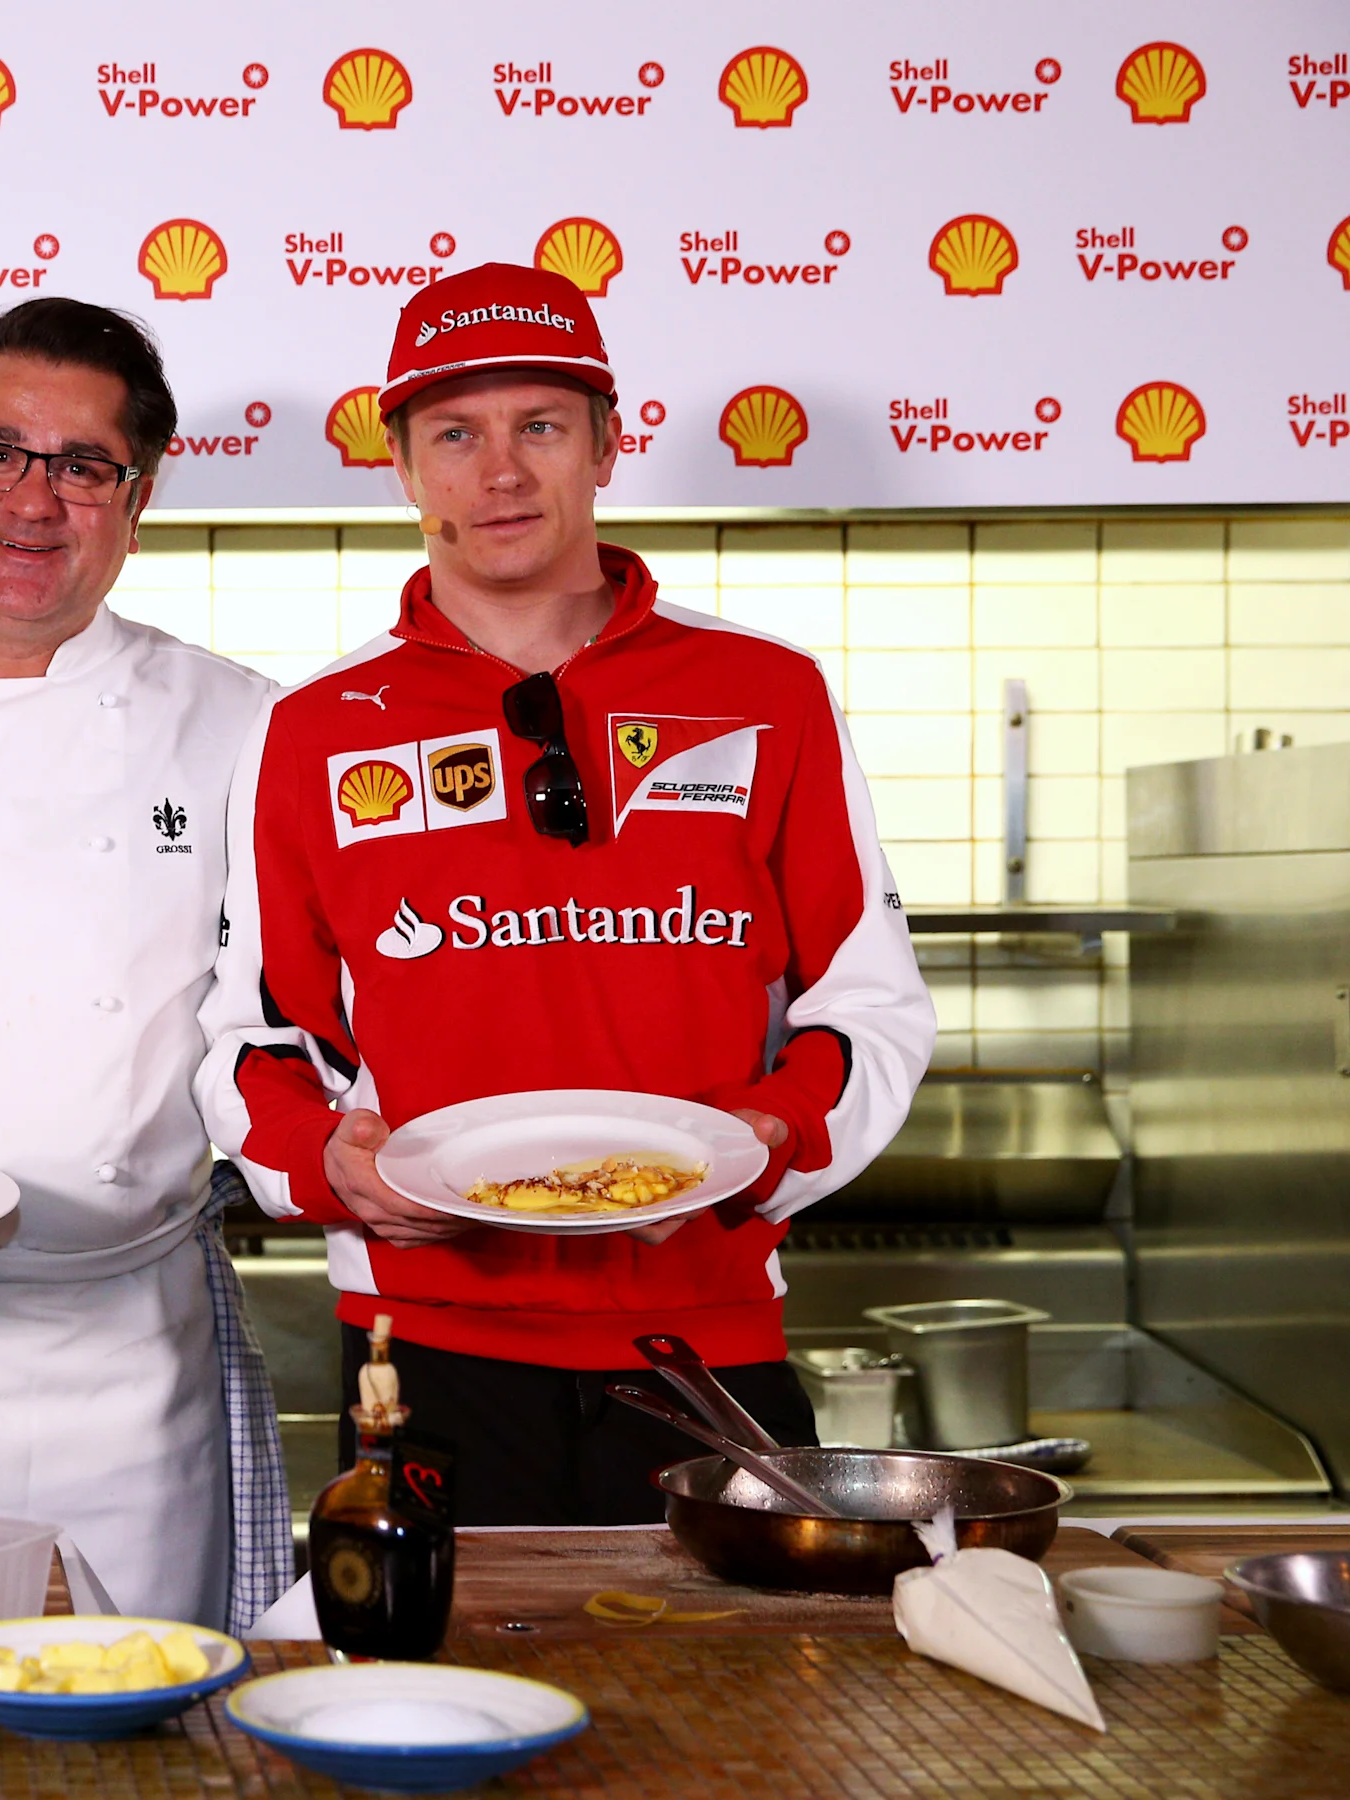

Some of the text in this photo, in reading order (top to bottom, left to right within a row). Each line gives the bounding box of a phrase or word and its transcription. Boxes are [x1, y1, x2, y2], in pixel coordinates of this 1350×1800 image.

[97, 63, 156, 85] Shell
[492, 62, 552, 84] Shell
[888, 59, 948, 81] Shell
[1288, 53, 1348, 76] Shell
[97, 88, 256, 118] V-Power
[494, 88, 652, 117] V-Power
[889, 84, 1049, 114] V-Power
[284, 232, 343, 254] Shell
[679, 230, 738, 253] Shell
[1075, 226, 1135, 249] Shell
[285, 257, 443, 287] V-Power
[680, 256, 839, 286] V-Power
[1076, 251, 1236, 282] V-Power
[440, 303, 576, 334] Santander
[888, 398, 948, 420] Shell
[1287, 393, 1347, 416] Shell
[164, 435, 259, 457] ower
[889, 424, 1050, 453] V-Power
[433, 762, 491, 802] ups
[651, 782, 734, 793] SCUDERIA
[155, 845, 192, 854] GROSSI
[448, 885, 753, 949] Santander
